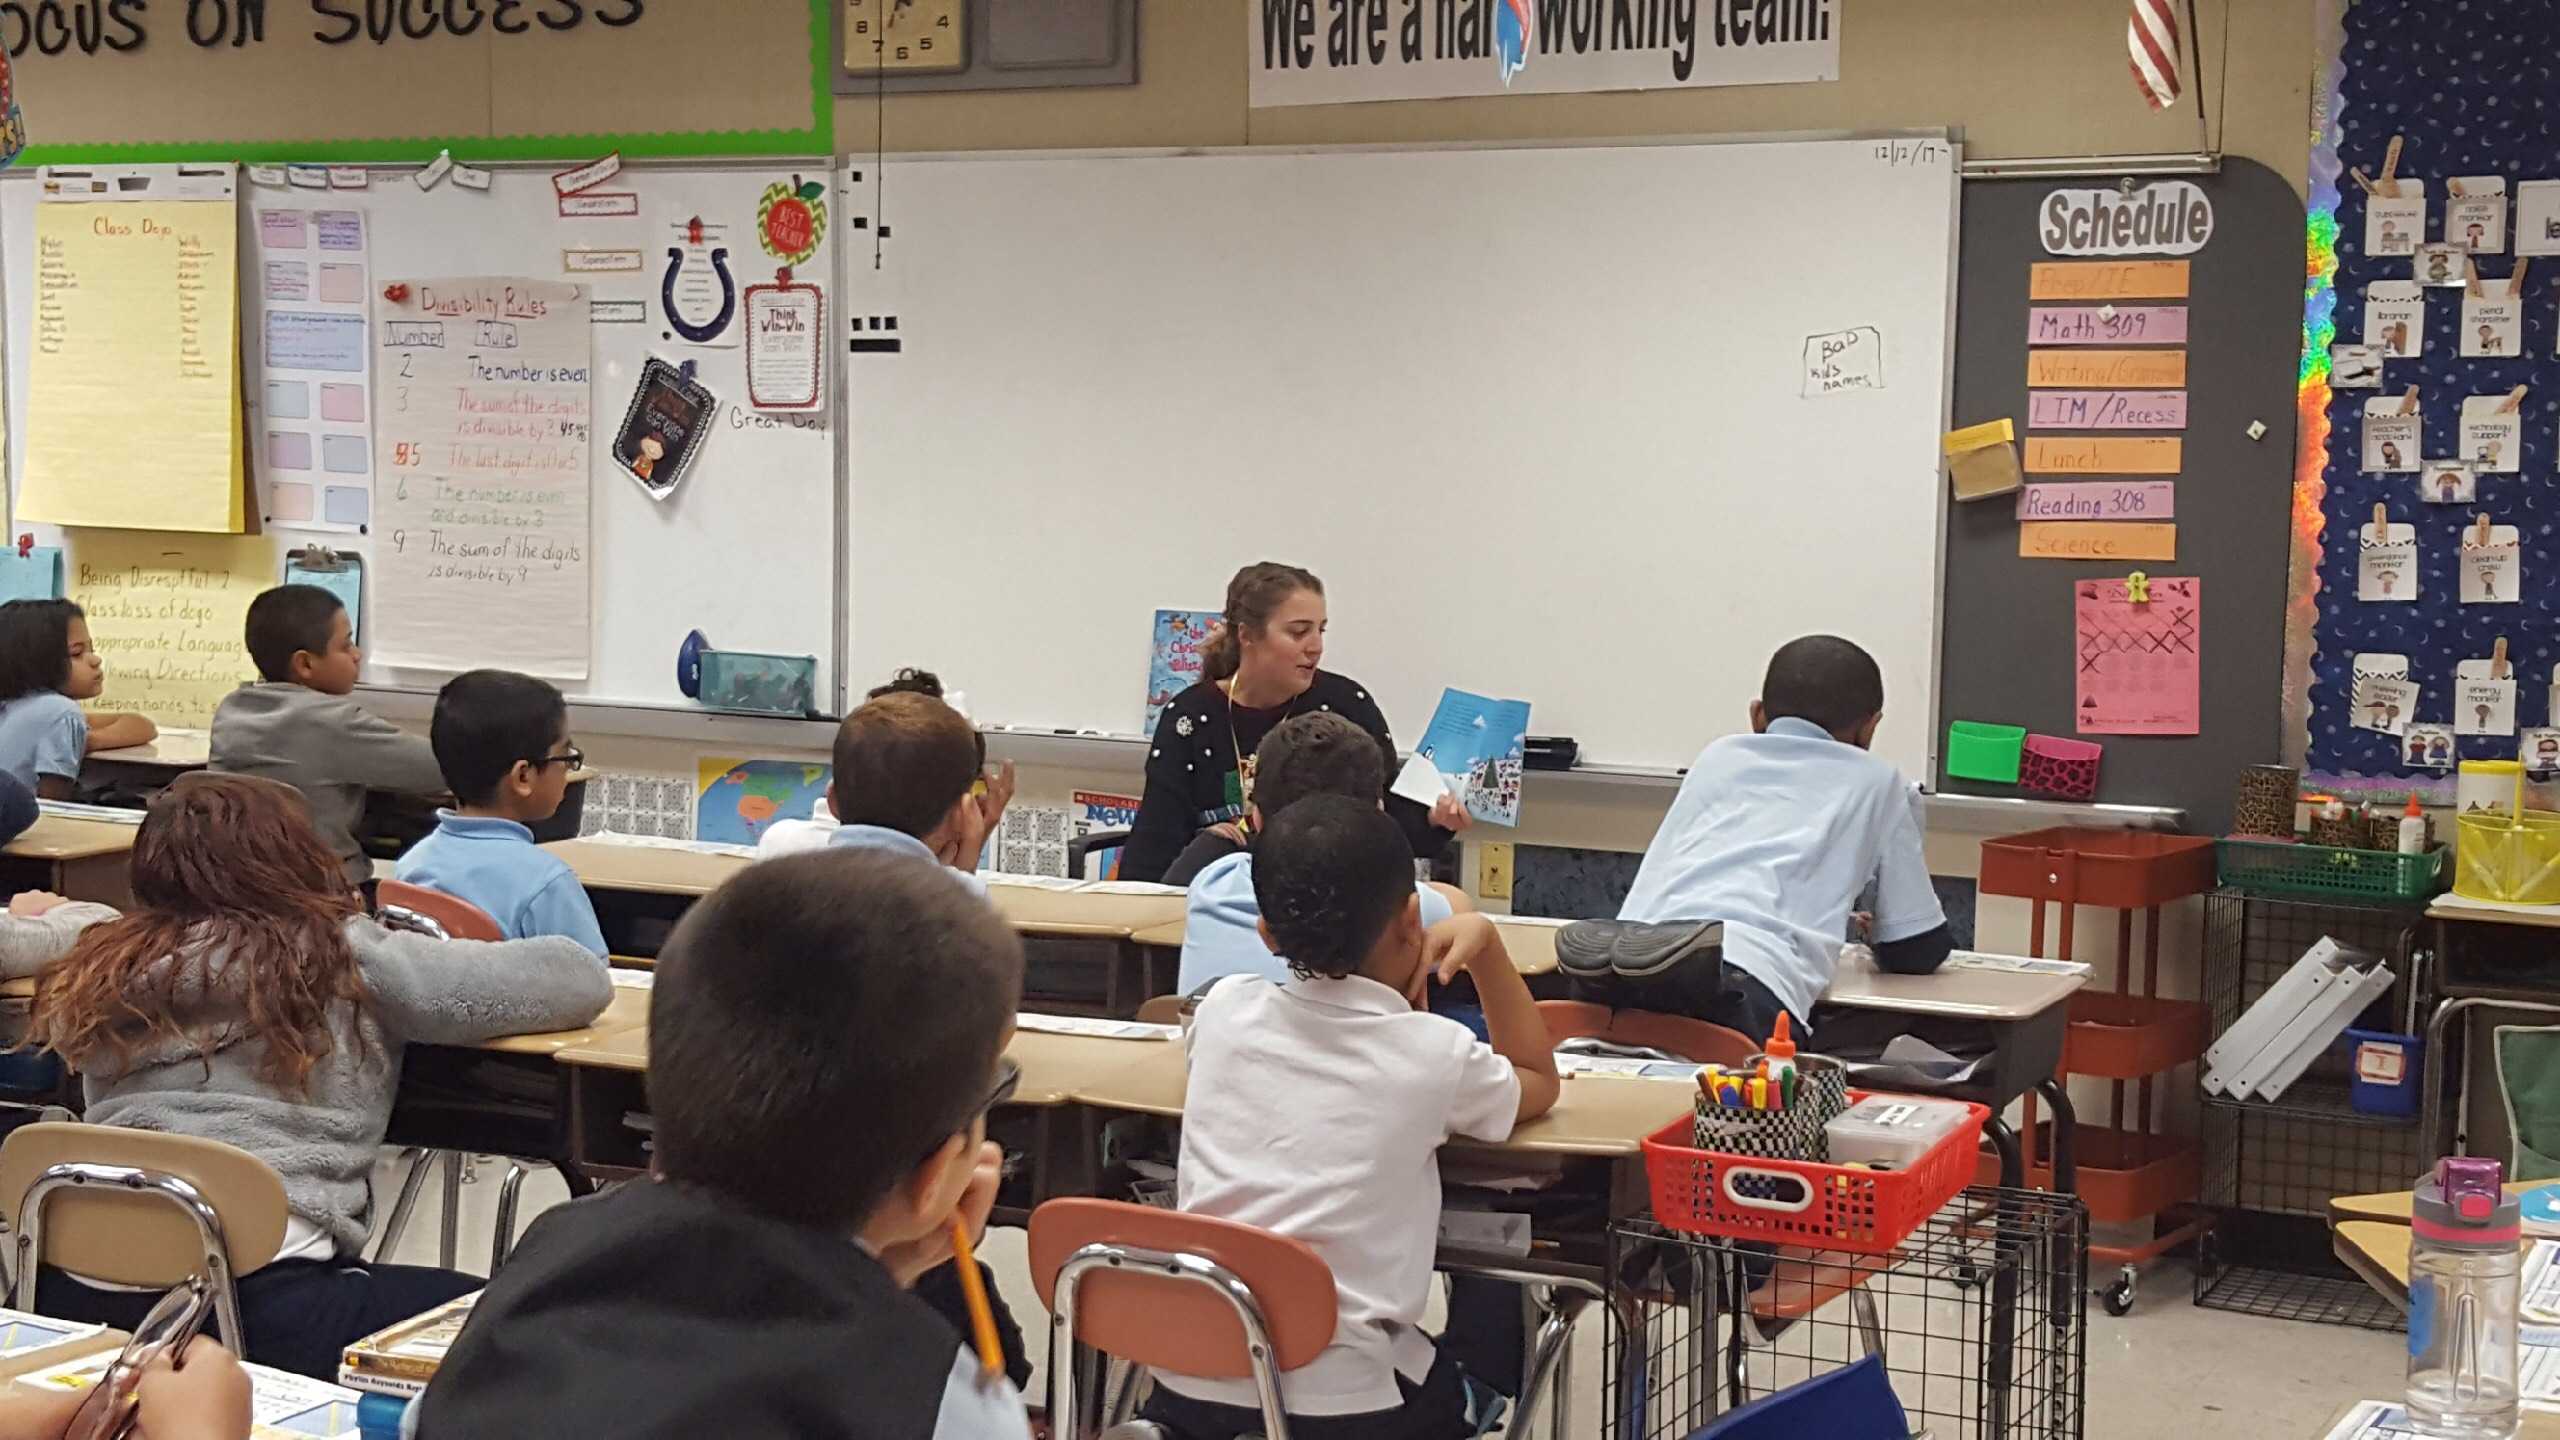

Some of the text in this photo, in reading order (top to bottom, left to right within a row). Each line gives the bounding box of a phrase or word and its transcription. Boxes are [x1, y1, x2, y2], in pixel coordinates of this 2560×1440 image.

[186, 0, 265, 47] ON
[856, 21, 868, 34] 8
[936, 15, 949, 29] 4
[920, 38, 932, 50] 5
[1263, 0, 1315, 69] We
[1328, 0, 1387, 66] are
[1400, 0, 1422, 63] a
[1435, 0, 1494, 60] har
[1538, 0, 1695, 81] working
[896, 47, 909, 60] 6
[94, 216, 132, 236] Class
[779, 206, 804, 226] BEST
[2045, 188, 2209, 250] Schedule
[422, 287, 547, 321] Divisibility Rules
[769, 308, 797, 320] Think
[387, 323, 443, 346] Number
[481, 322, 514, 347] Rule
[2040, 313, 2146, 340] Math 309
[400, 354, 414, 378] 2
[468, 356, 493, 381] The
[496, 362, 542, 382] number
[546, 367, 558, 382] is
[397, 386, 409, 412] 3
[730, 406, 783, 430] Great
[2038, 443, 2101, 469] Lunch
[2027, 489, 2145, 518] Reading 308
[393, 529, 580, 571] 9 The sum of the digits
[2035, 526, 2115, 554] Science
[80, 563, 121, 594] Being
[445, 564, 494, 581] divisible
[497, 565, 514, 585] by
[159, 599, 176, 618] of
[93, 630, 242, 662] appropriate Languag
[1084, 794, 1140, 809] SCHOLAST
[1086, 804, 1138, 827] New
